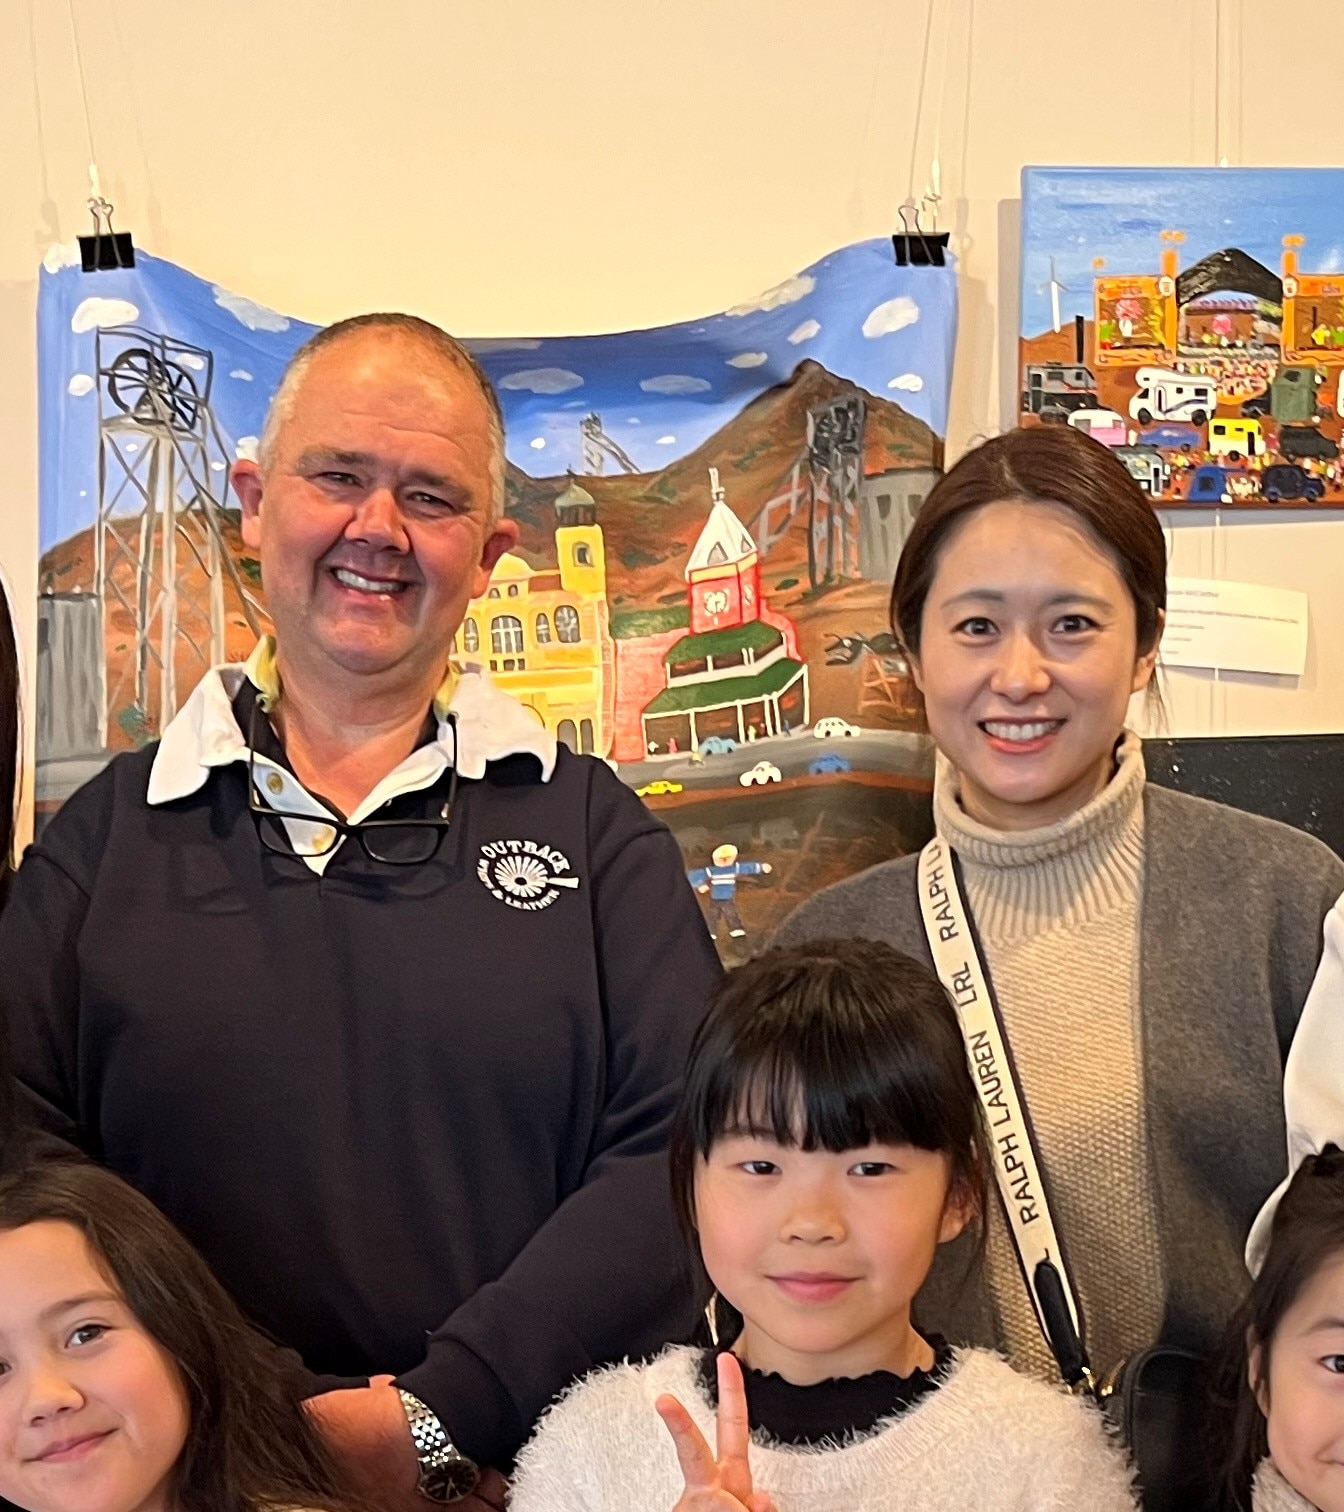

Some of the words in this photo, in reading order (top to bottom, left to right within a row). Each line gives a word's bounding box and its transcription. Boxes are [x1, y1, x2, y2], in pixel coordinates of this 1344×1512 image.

[480, 840, 571, 875] OUTBACK
[926, 865, 960, 943] RALPH
[951, 960, 979, 1008] LRL
[969, 1029, 1012, 1128] LAUREN
[997, 1132, 1041, 1226] RALPH
